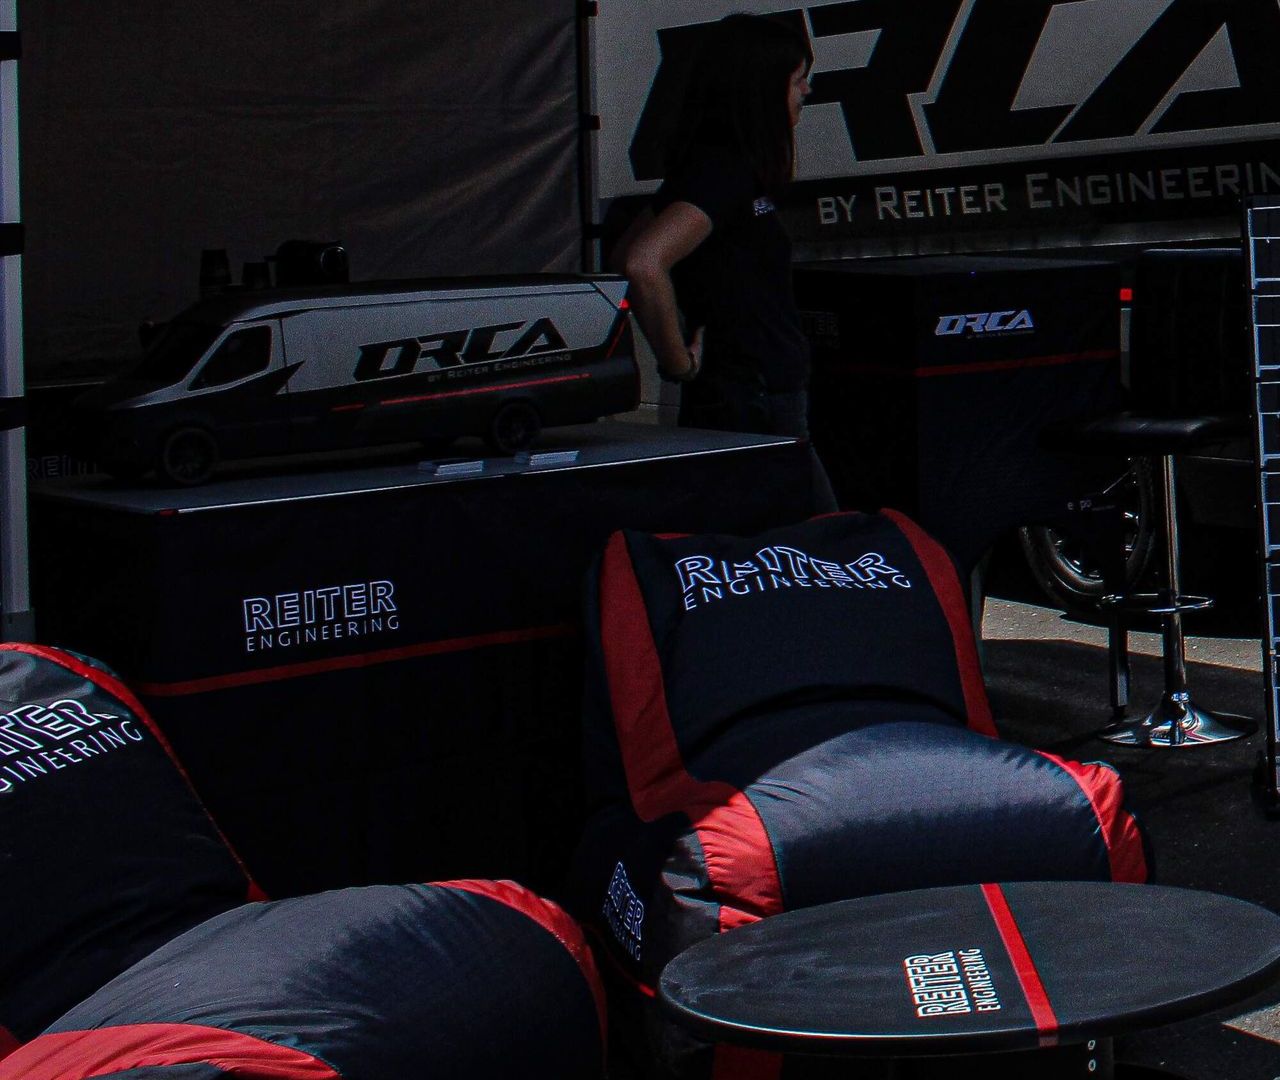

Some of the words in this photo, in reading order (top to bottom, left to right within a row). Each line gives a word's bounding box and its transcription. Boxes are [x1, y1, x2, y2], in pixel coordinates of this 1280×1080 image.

[353, 317, 568, 381] ORCA
[934, 308, 1038, 336] ORCA
[243, 580, 397, 633] REITER
[246, 615, 400, 652] ENGINEERING
[903, 950, 972, 1018] REITER
[957, 947, 1002, 1013] ENGINEERING
